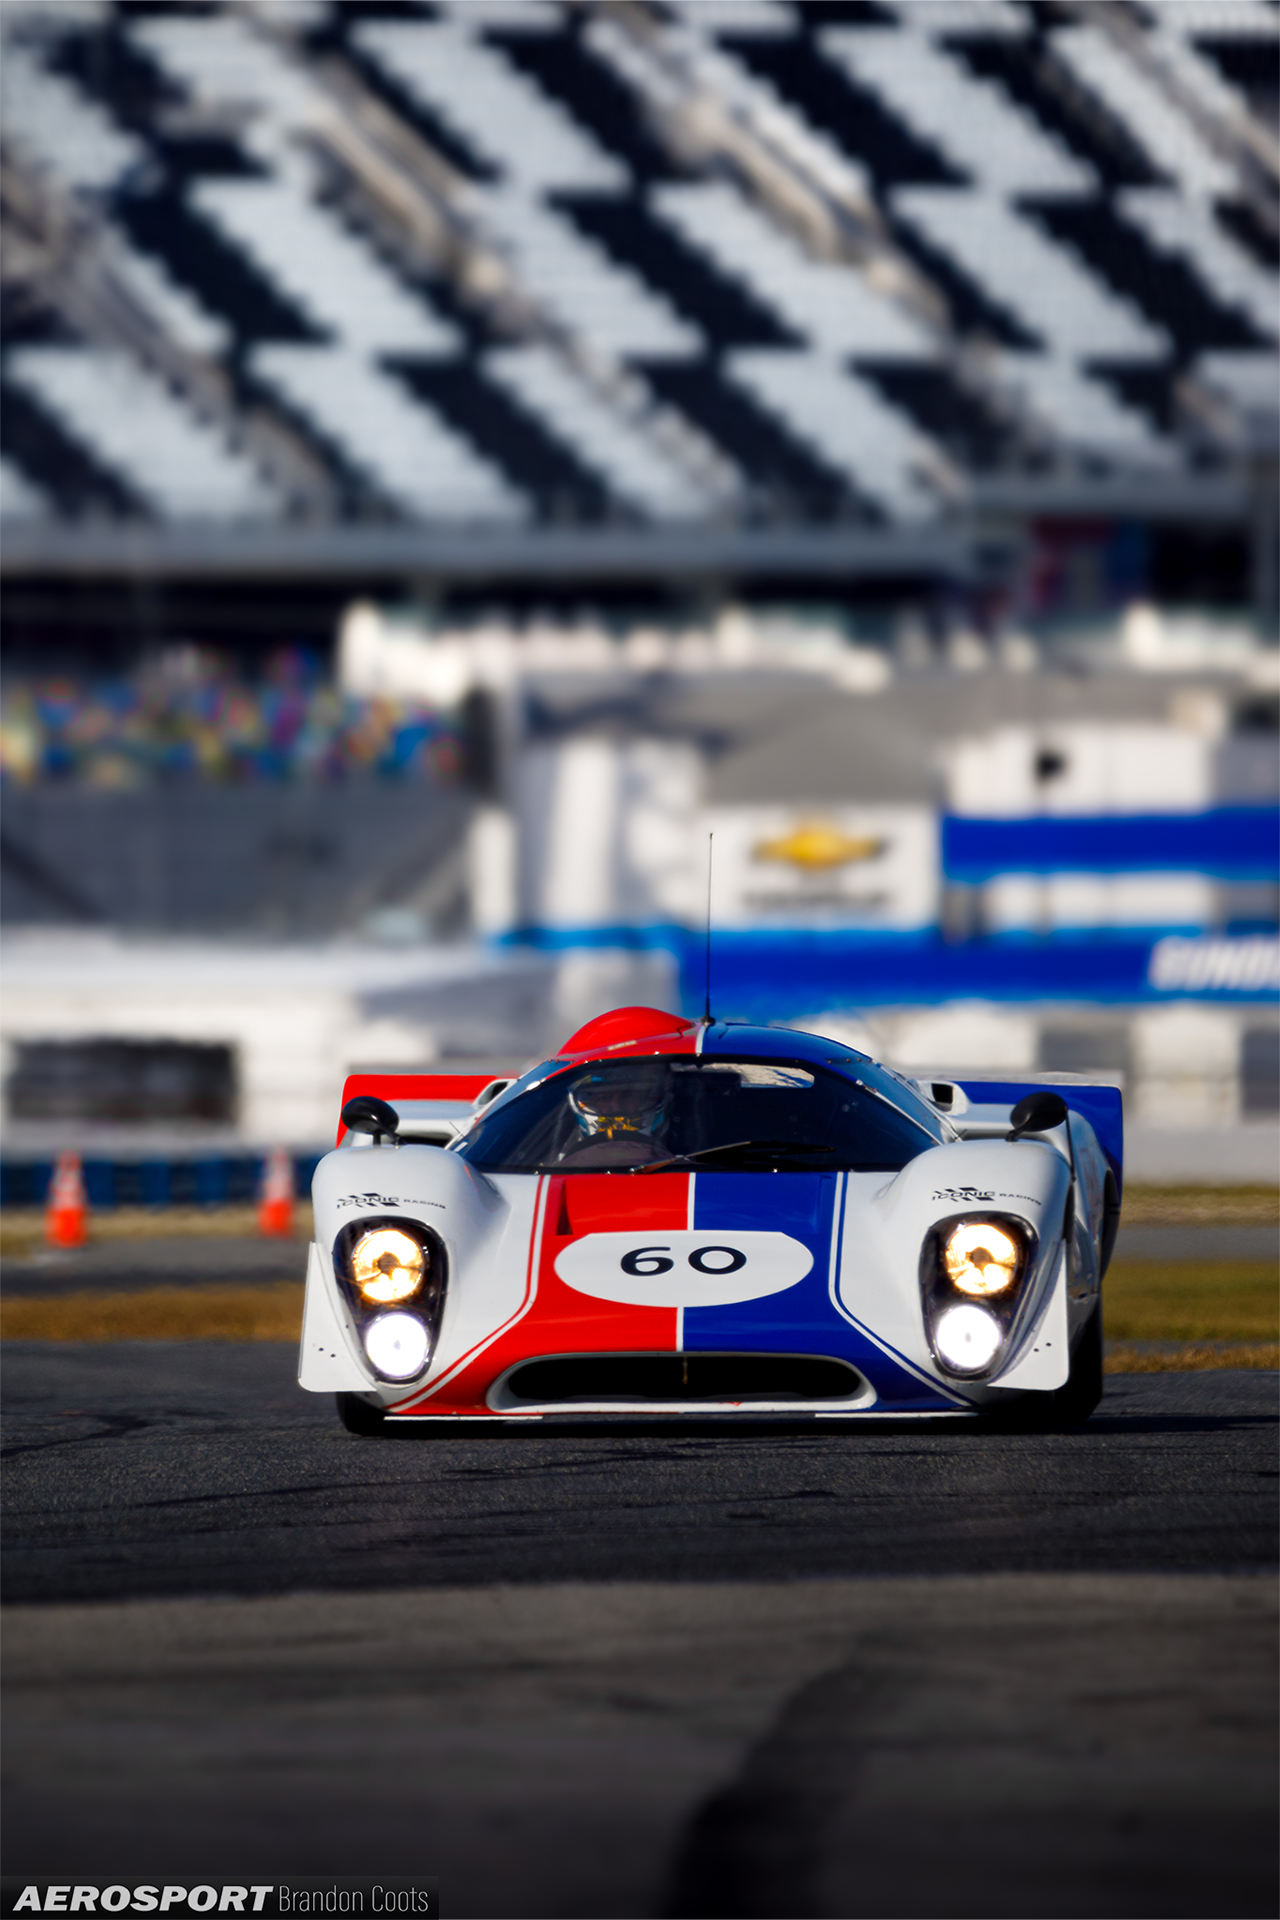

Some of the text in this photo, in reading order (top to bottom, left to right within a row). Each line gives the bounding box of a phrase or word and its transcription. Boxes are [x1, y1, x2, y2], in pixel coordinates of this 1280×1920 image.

[932, 1190, 995, 1201] ICONIC
[337, 1196, 400, 1209] ICONIC
[620, 1246, 747, 1276] 60
